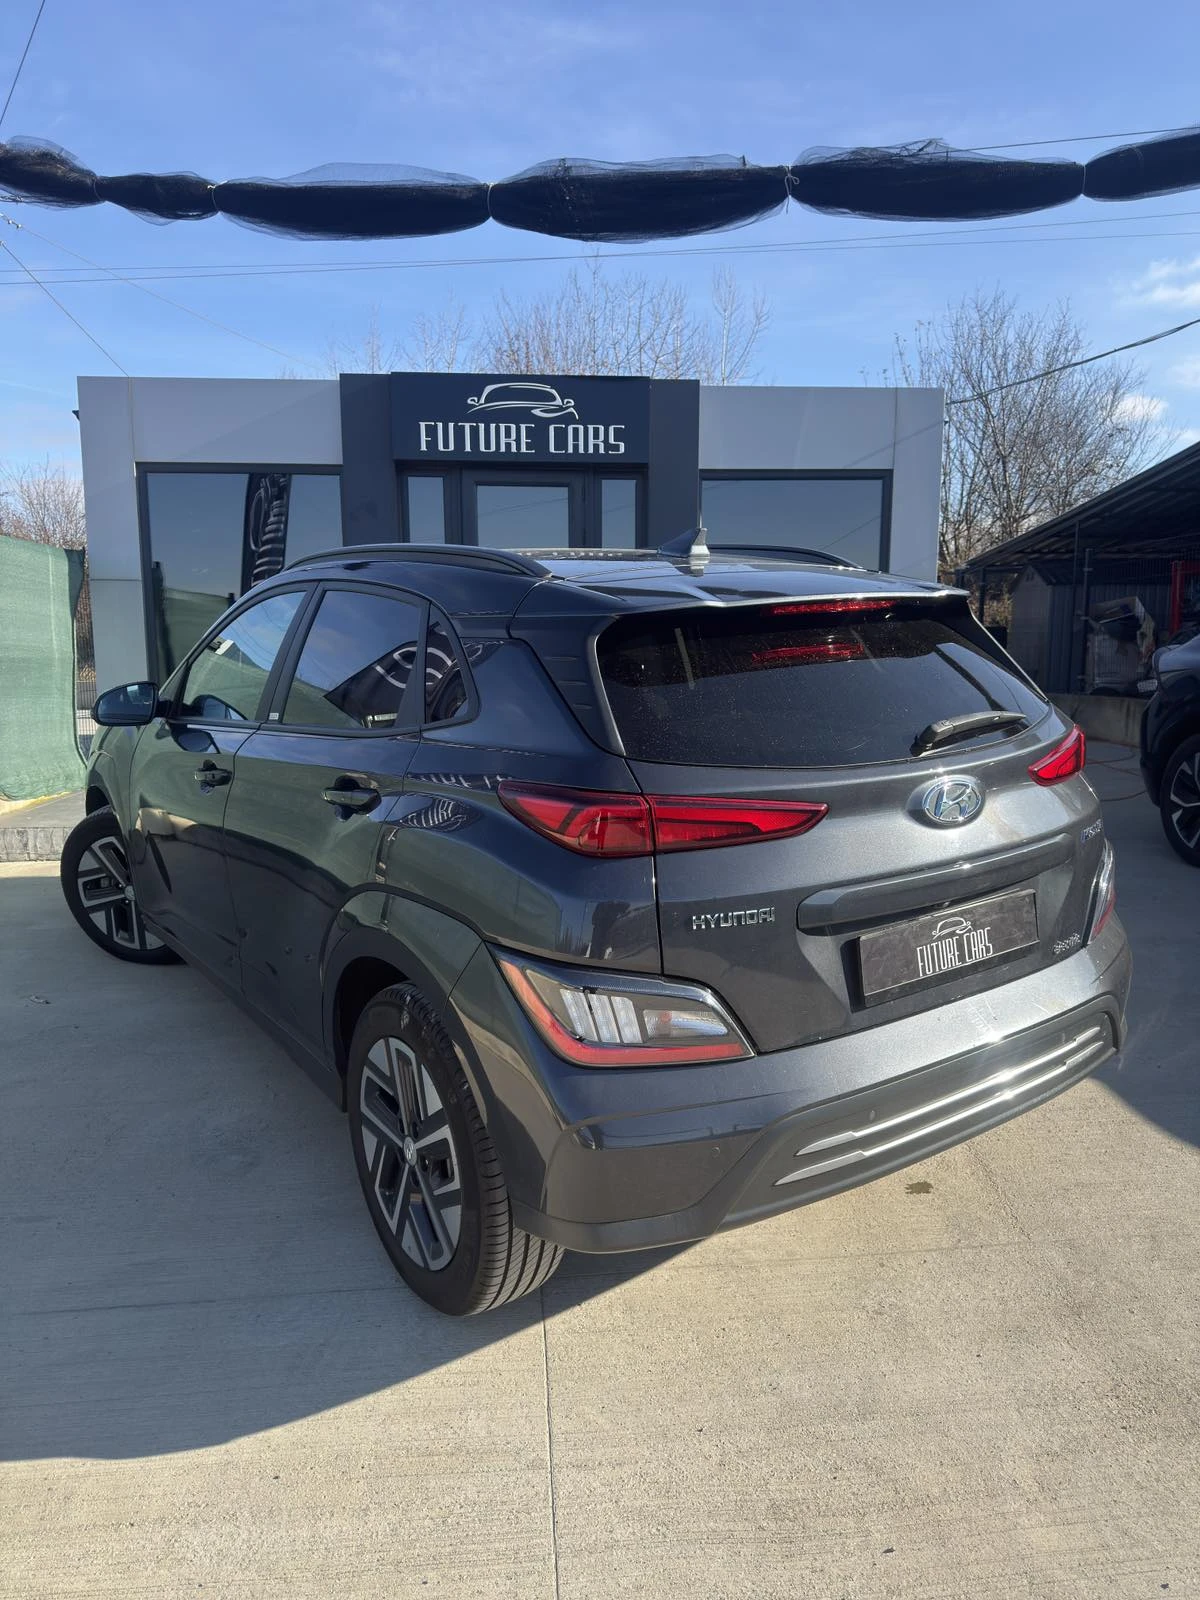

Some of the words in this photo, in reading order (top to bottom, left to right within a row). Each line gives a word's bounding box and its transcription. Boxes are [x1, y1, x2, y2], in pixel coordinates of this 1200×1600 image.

[418, 421, 535, 453] FUTURE
[548, 424, 625, 454] CARS
[692, 906, 775, 930] HYUNDAI
[916, 936, 962, 977] FUTURE
[963, 926, 993, 962] CARS
